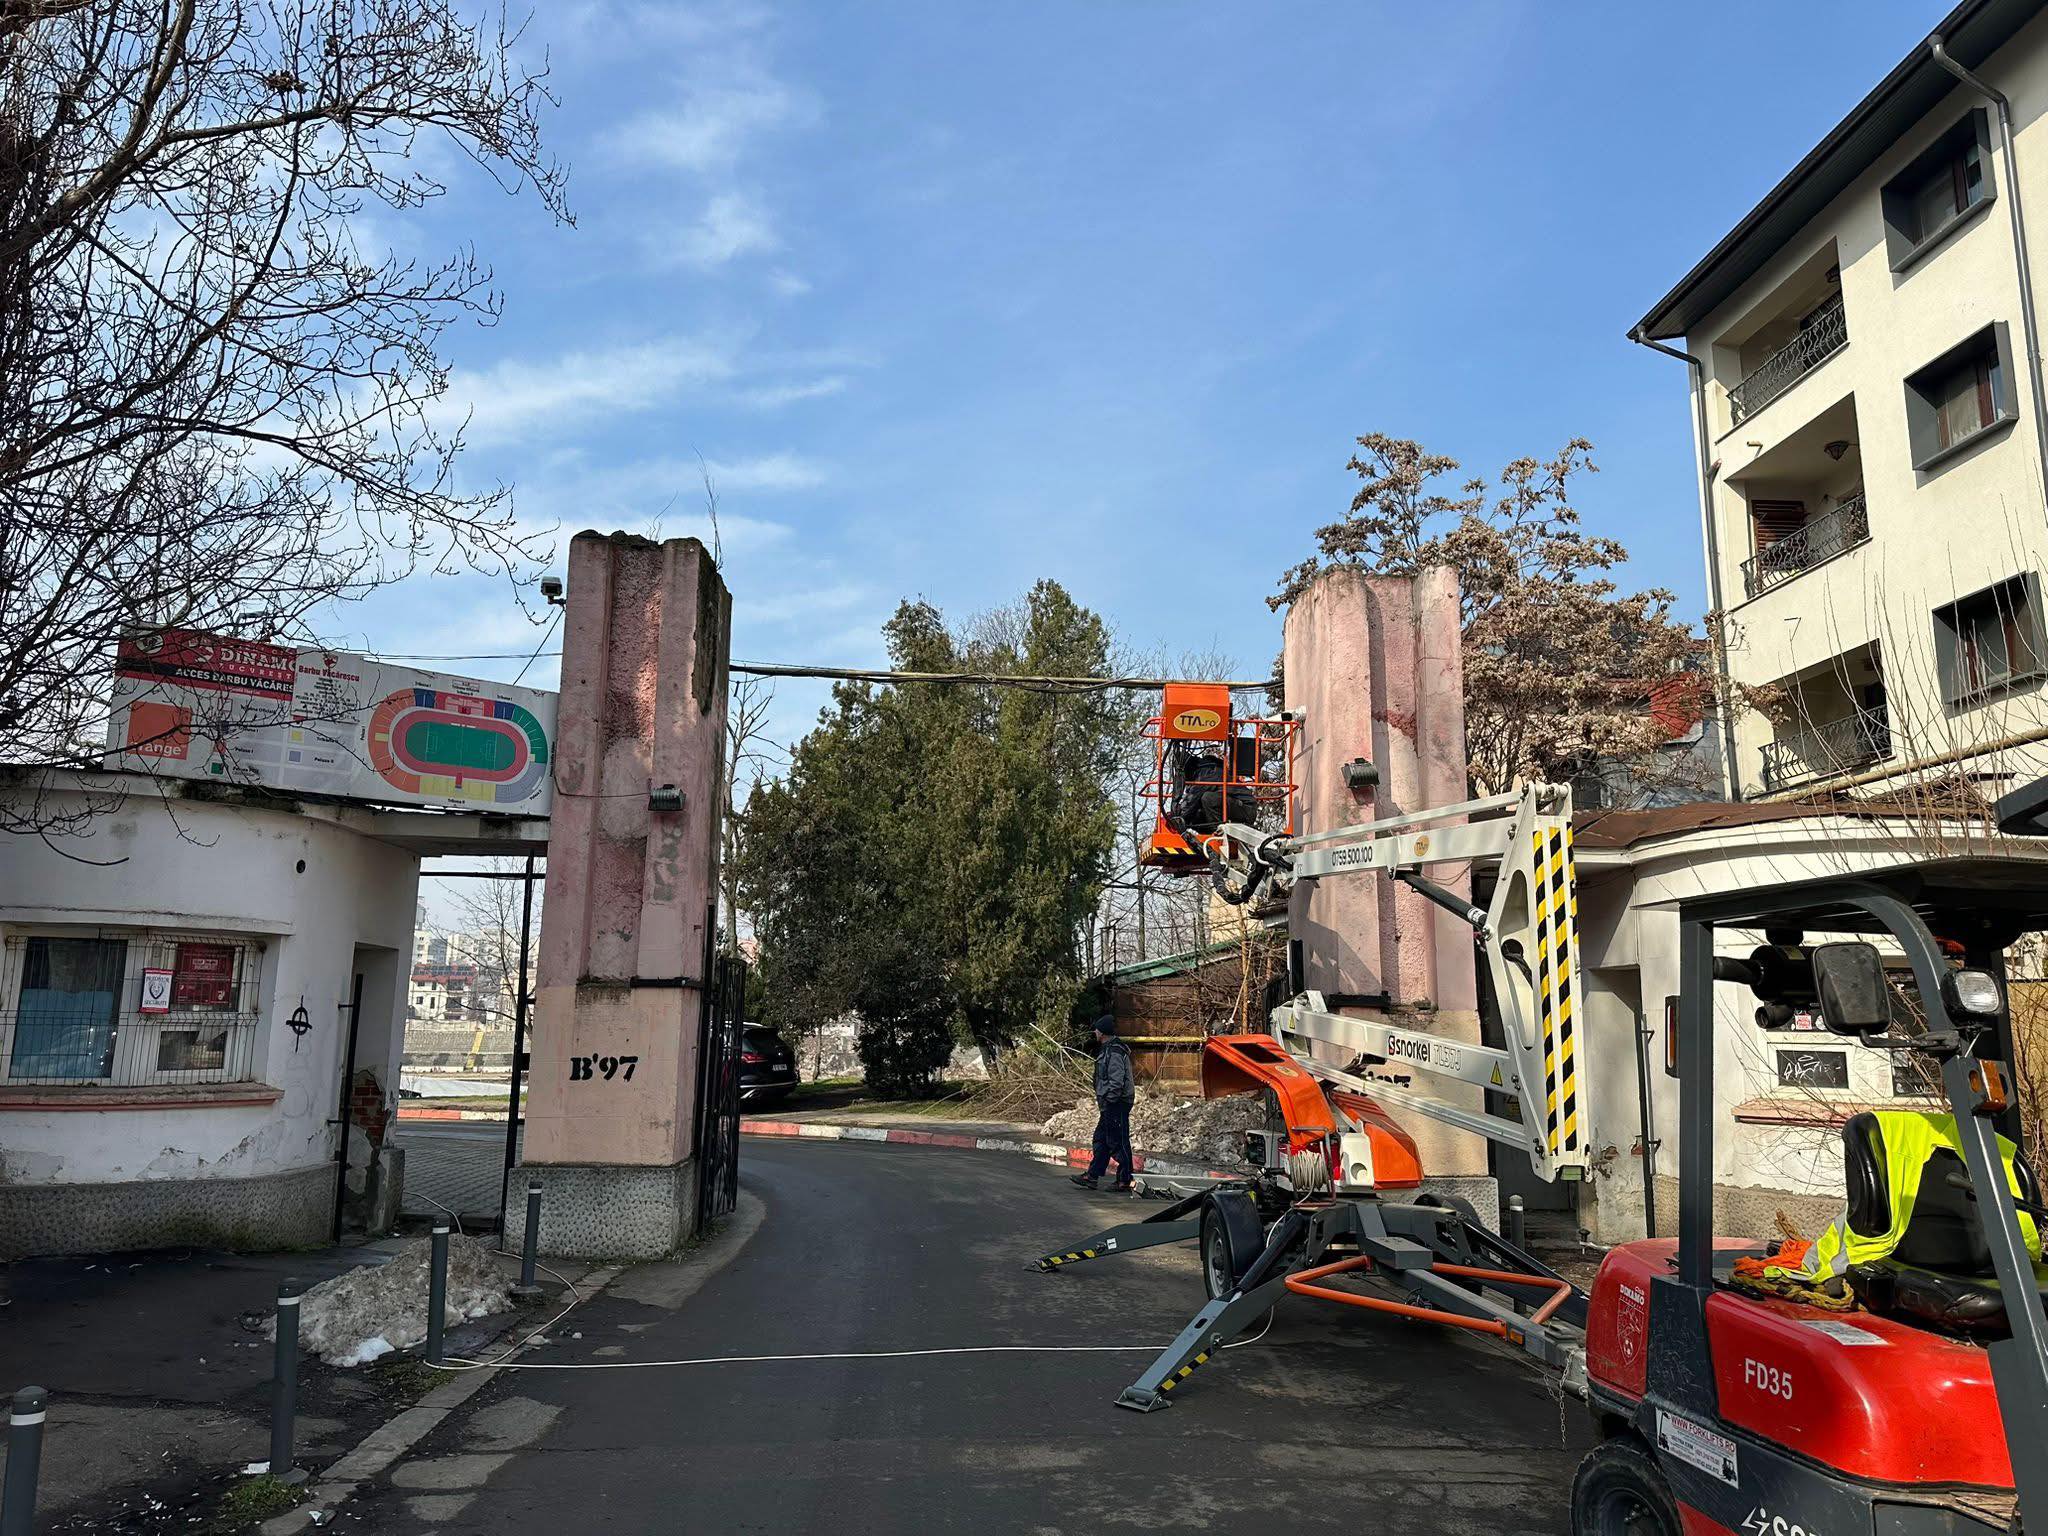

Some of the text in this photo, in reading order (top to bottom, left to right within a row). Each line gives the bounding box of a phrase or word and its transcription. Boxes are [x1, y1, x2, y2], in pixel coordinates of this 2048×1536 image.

[299, 665, 320, 676] Barbu
[1396, 1038, 1431, 1062] snorkel
[569, 1053, 639, 1081] B'97
[1745, 1357, 1793, 1400] FD35
